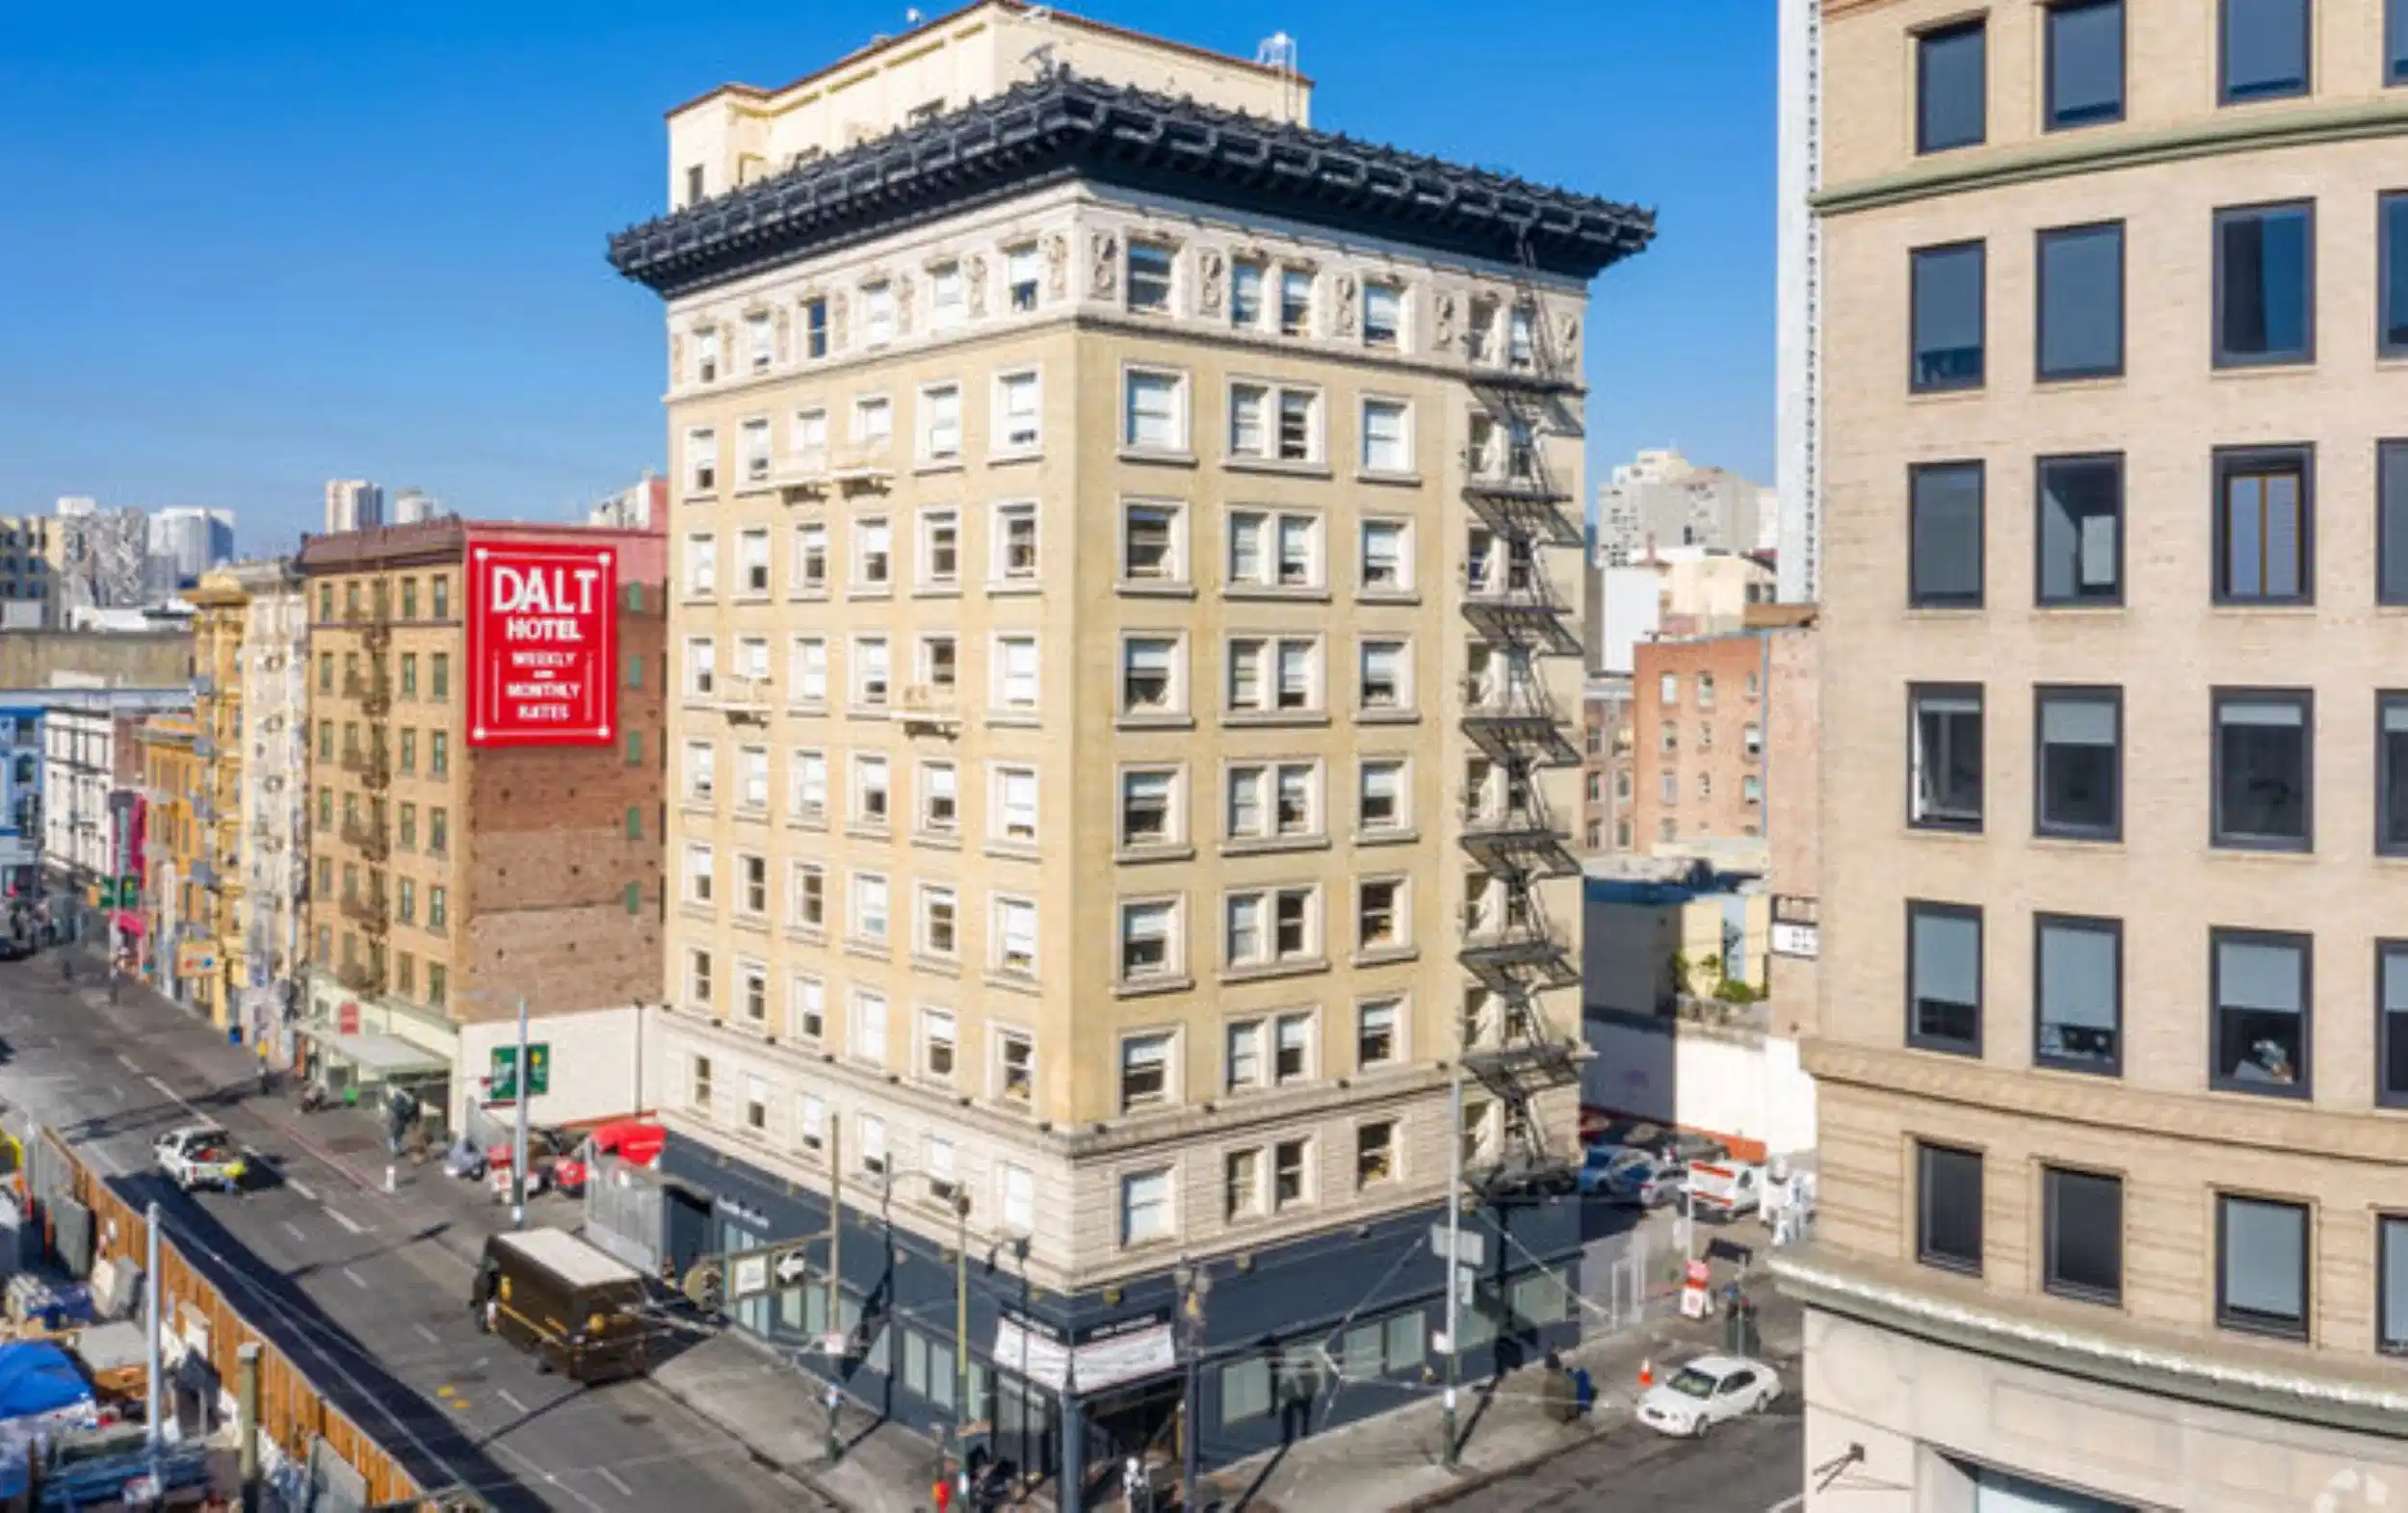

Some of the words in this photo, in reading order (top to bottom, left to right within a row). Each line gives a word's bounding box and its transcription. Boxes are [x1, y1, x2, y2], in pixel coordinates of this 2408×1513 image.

[492, 566, 598, 613] DALT
[507, 617, 584, 640] HOTEL
[506, 683, 581, 698] MONTHLY
